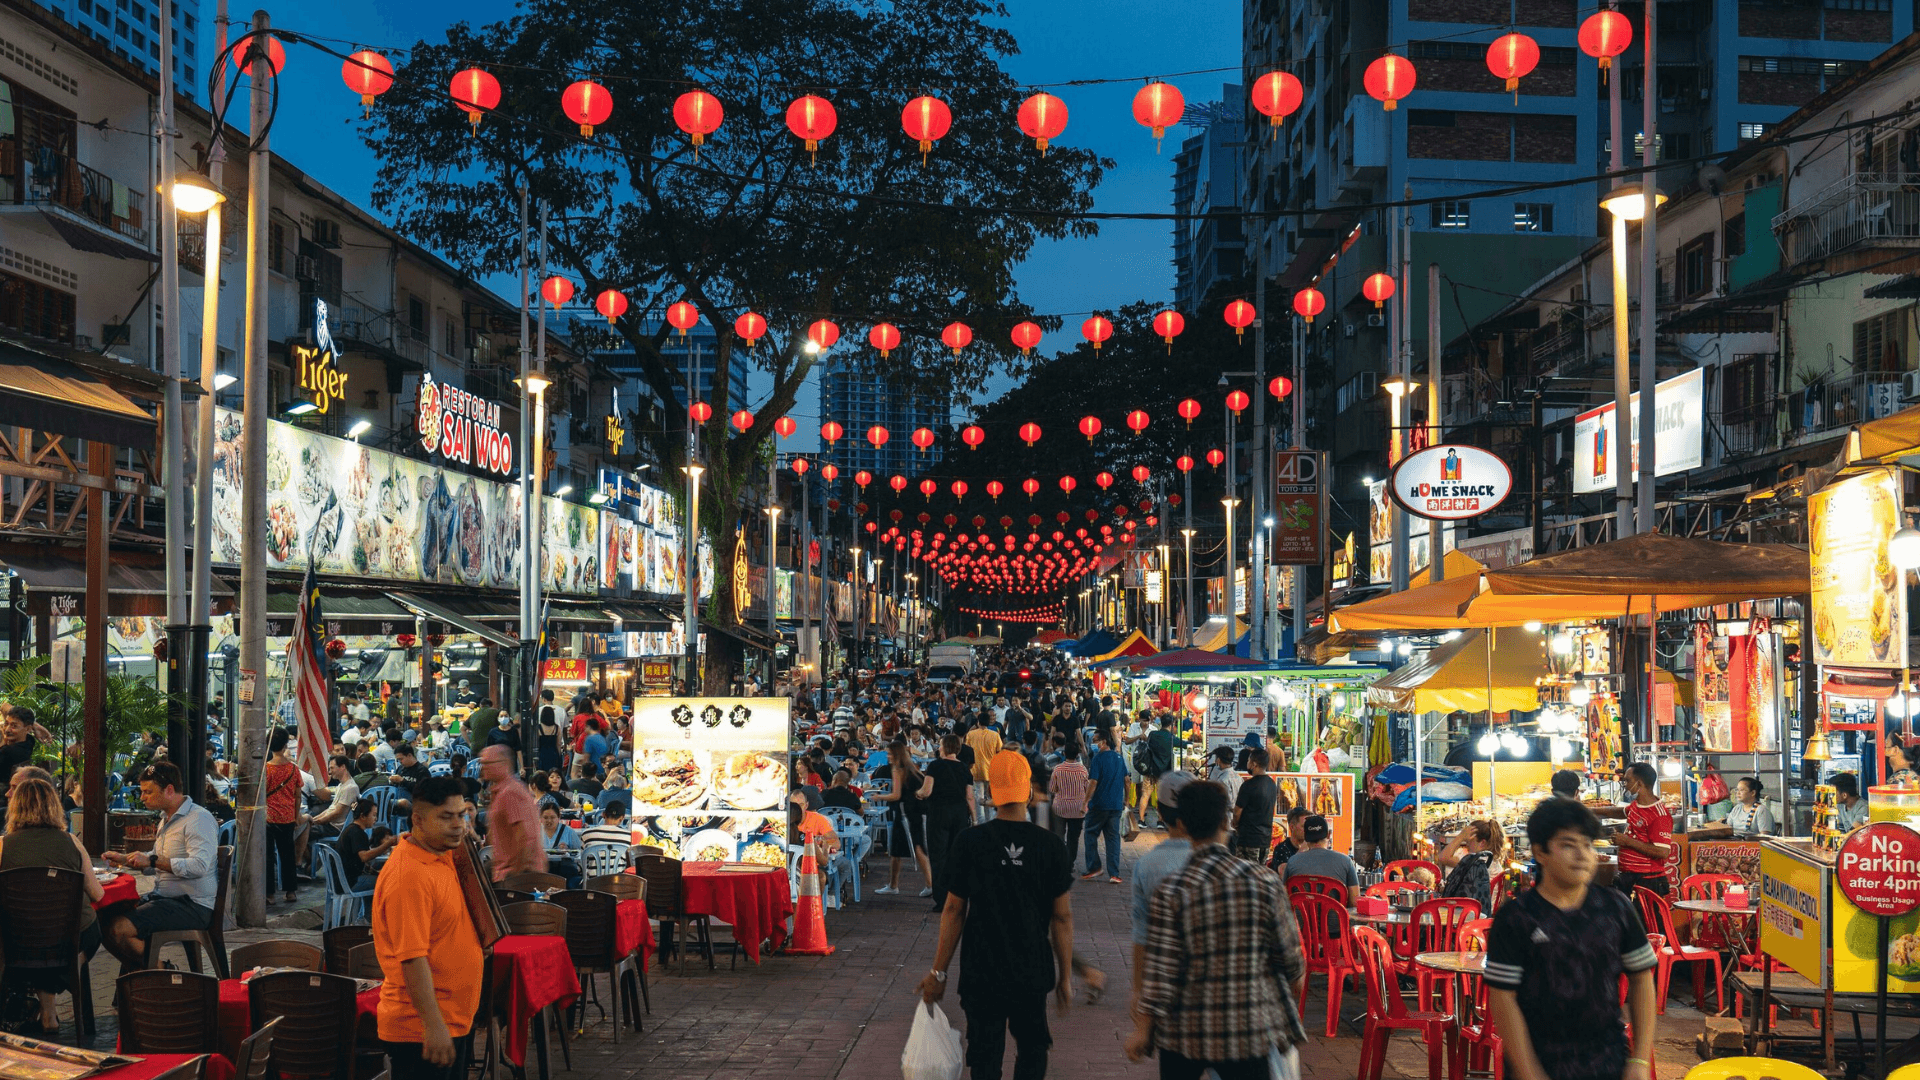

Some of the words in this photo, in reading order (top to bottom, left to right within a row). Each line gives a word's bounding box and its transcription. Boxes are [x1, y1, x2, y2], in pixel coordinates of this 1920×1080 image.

[297, 346, 348, 414] Tiger
[443, 382, 500, 429] RESTORAN
[442, 411, 471, 465] SAI
[474, 421, 512, 476] WOO
[607, 415, 625, 455] Tiger
[1278, 454, 1317, 482] 4D
[1280, 485, 1298, 493] TOTO
[1410, 483, 1449, 497] HOME
[1452, 485, 1495, 497] SNACK
[1427, 498, 1479, 511] 南洋特产
[1127, 551, 1152, 570] KK
[58, 595, 77, 614] Tiger
[547, 670, 579, 679] SATAY
[1697, 845, 1716, 857] Fat
[1871, 835, 1903, 853] No
[1843, 852, 1920, 878] Parking
[1849, 877, 1880, 889] after
[1856, 894, 1891, 903] Business
[1892, 896, 1915, 905] Usage
[1876, 901, 1895, 909] Area
